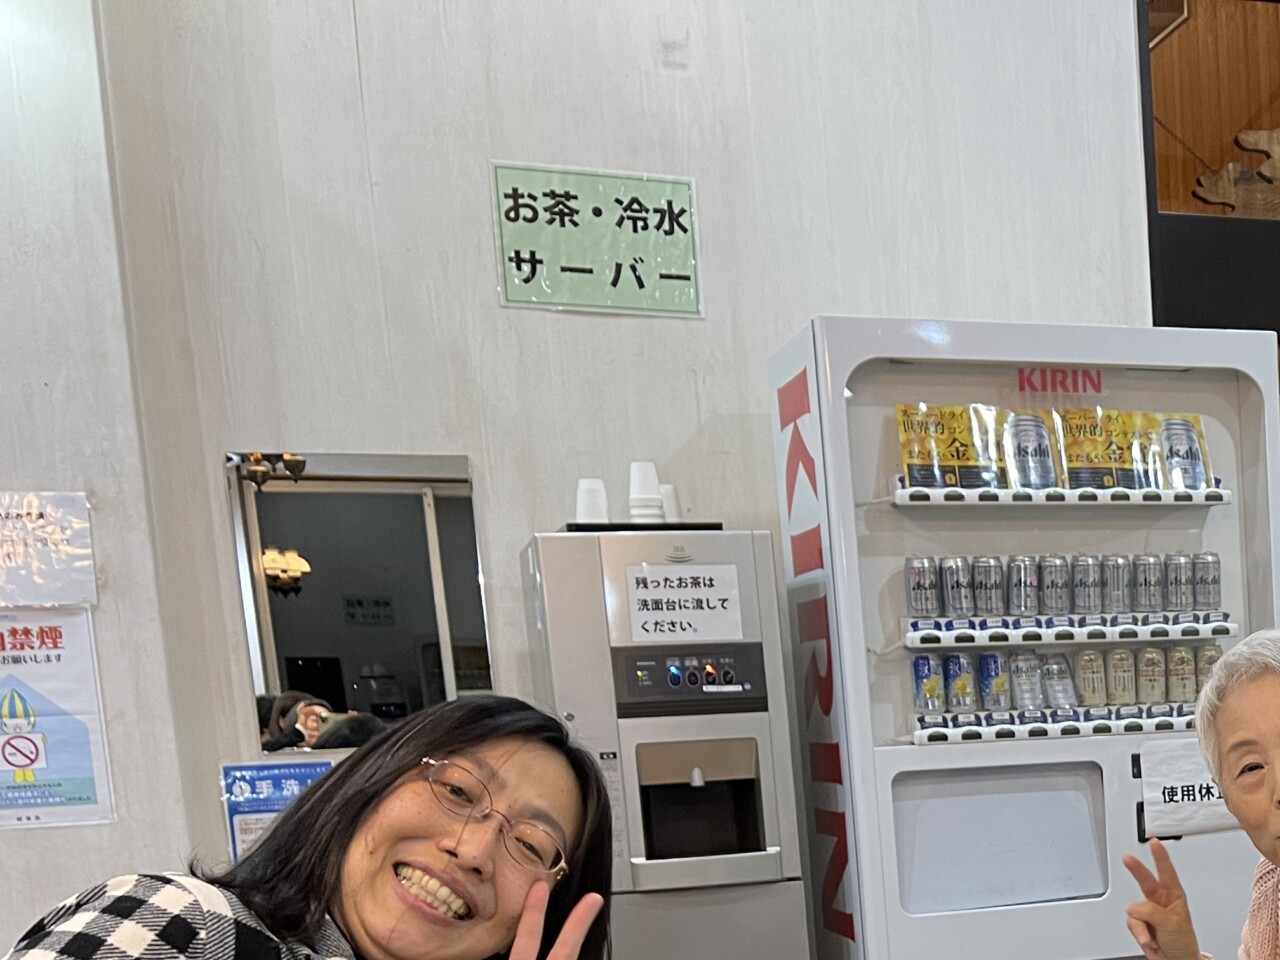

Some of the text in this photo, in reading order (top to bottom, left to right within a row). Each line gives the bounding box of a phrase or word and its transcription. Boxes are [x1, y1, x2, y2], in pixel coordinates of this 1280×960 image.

[503, 187, 689, 236] お茶・冷水
[508, 250, 691, 289] サーバー
[1018, 367, 1102, 393] KIRIN
[635, 576, 715, 590] 残ったお茶は
[637, 597, 729, 611] 洗面台に流して
[641, 620, 698, 633] ください。
[777, 366, 856, 944] KIRIN
